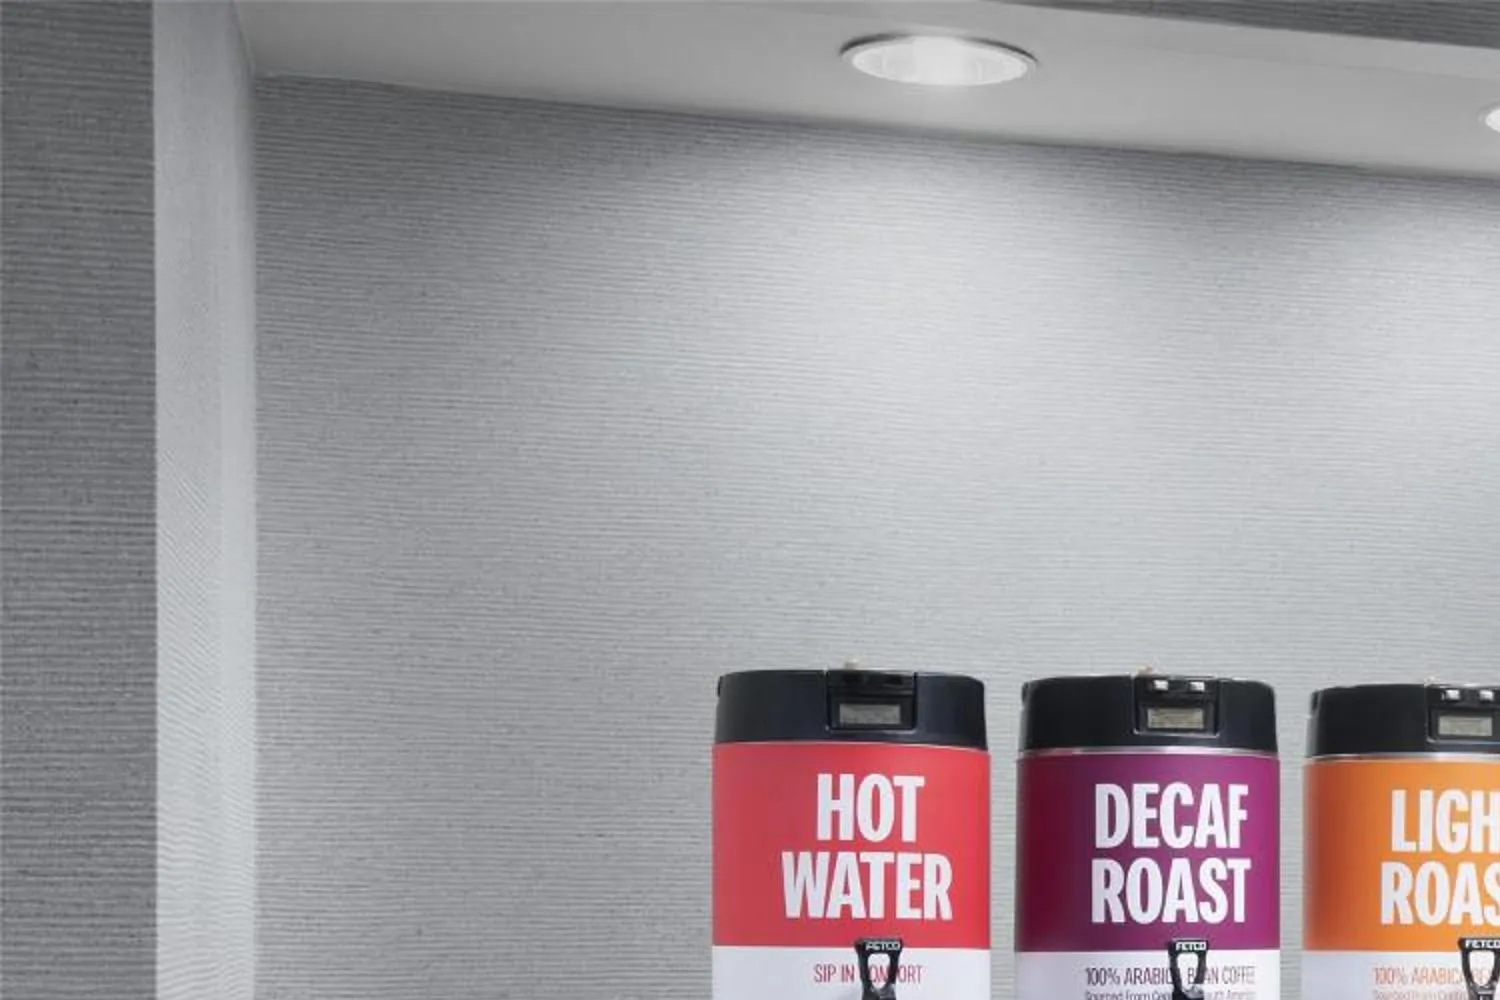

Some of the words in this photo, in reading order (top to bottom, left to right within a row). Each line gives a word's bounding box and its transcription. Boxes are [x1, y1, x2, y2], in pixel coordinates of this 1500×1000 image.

[816, 773, 924, 843] HOT
[1095, 783, 1249, 848] DECAF
[782, 851, 953, 921] WATER
[1091, 858, 1252, 924] ROAST
[813, 964, 837, 983] SIP
[841, 964, 855, 983] IN
[1085, 967, 1121, 986] 100%
[1374, 966, 1409, 985] 100%
